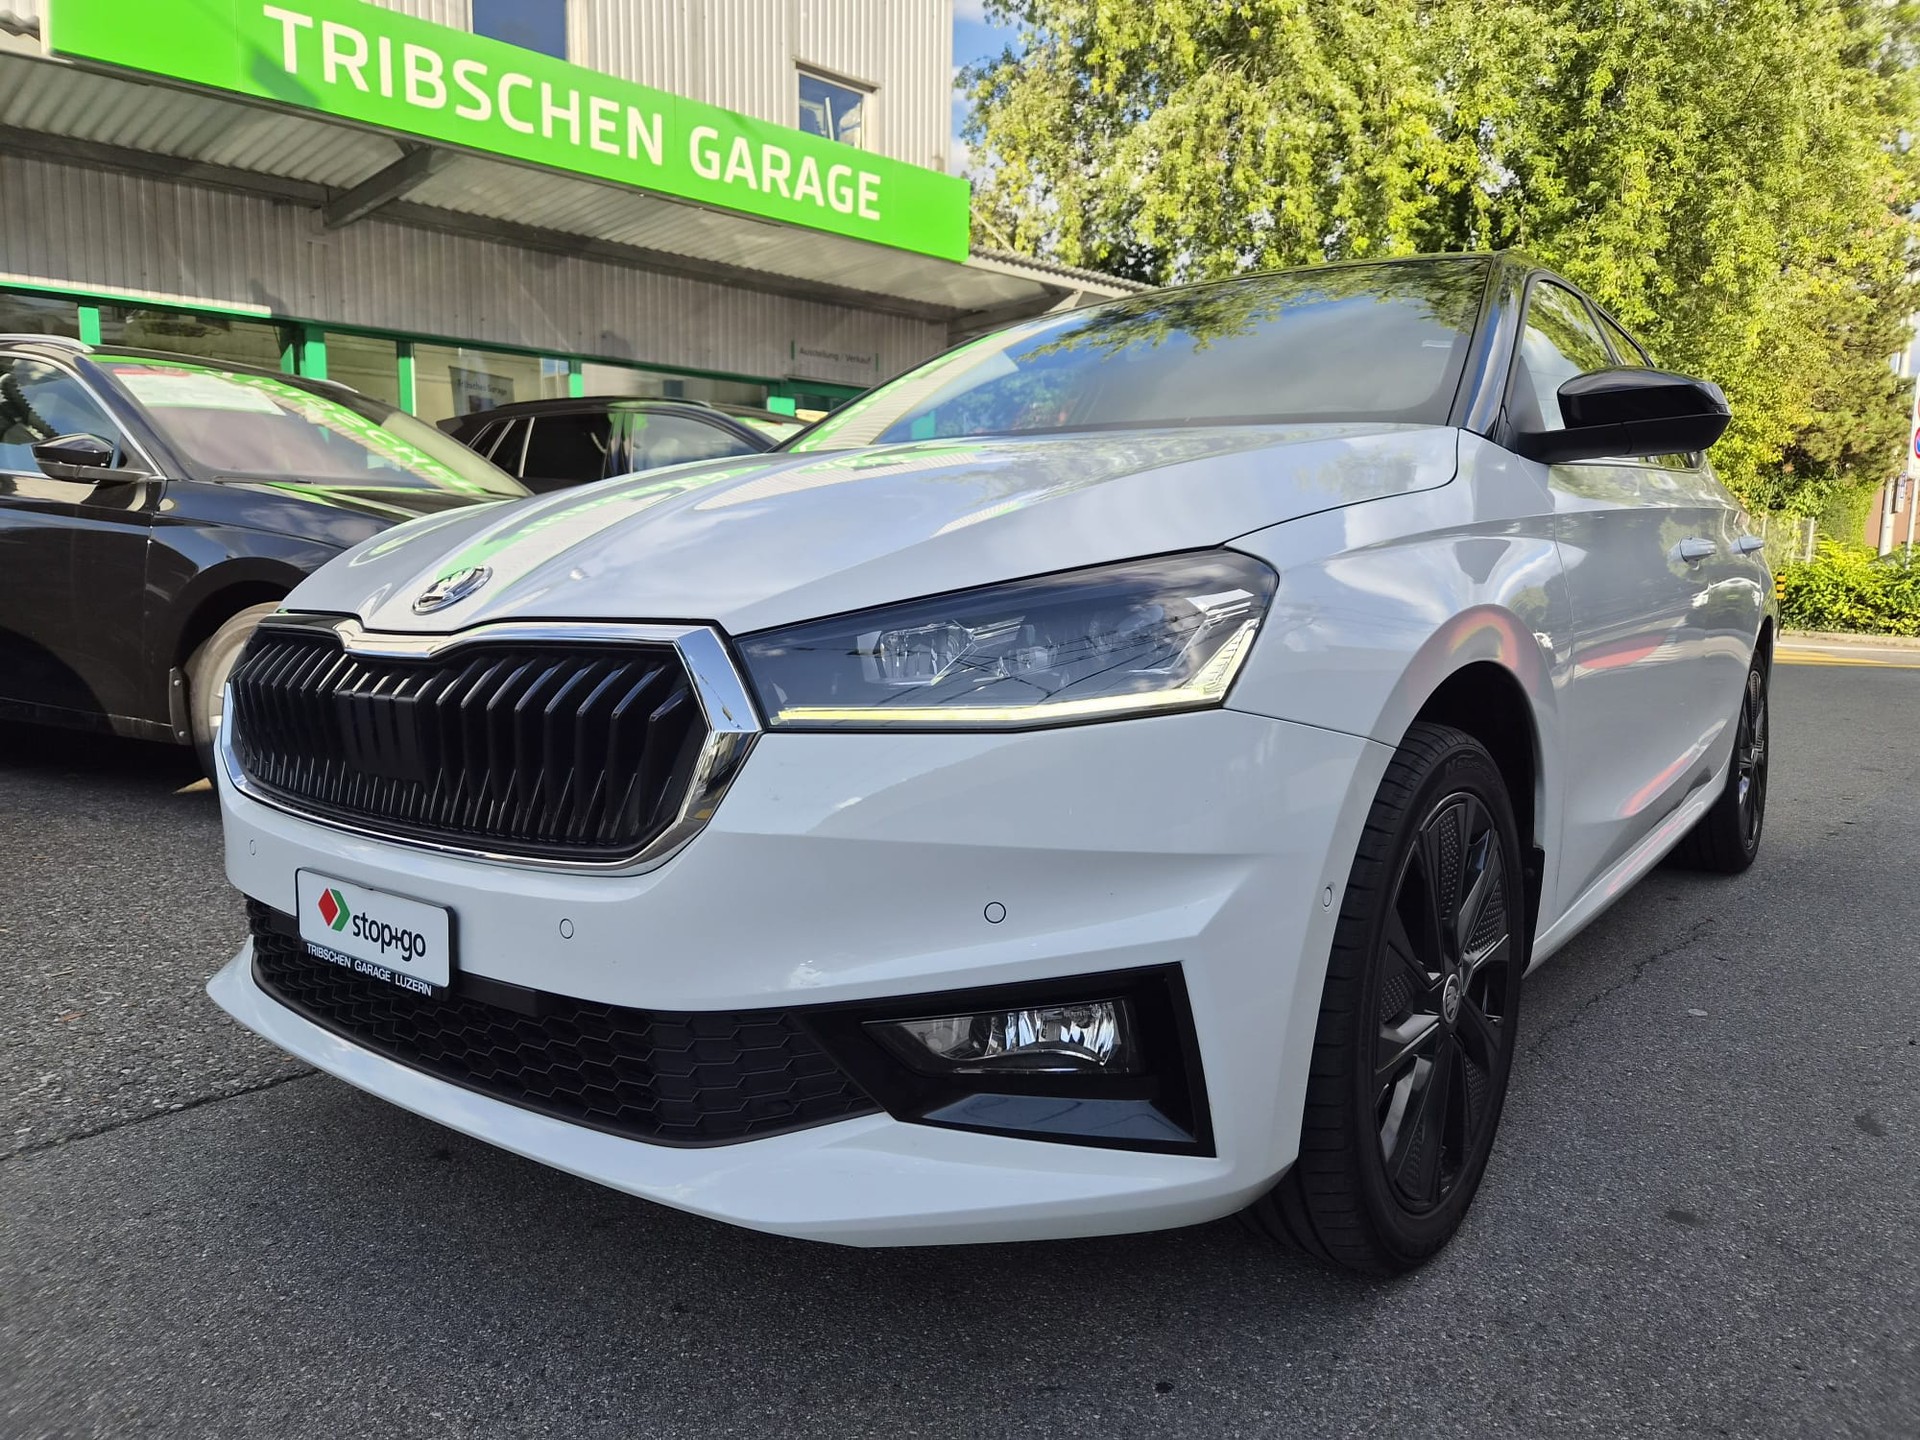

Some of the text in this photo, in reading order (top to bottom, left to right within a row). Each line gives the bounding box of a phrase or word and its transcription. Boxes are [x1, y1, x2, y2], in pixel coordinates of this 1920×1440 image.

[262, 3, 882, 221] TRIBSCHEN GARAGE
[352, 912, 426, 962] stop+go
[306, 942, 432, 997] TRIBSCHEN GARAGE LUZERN
